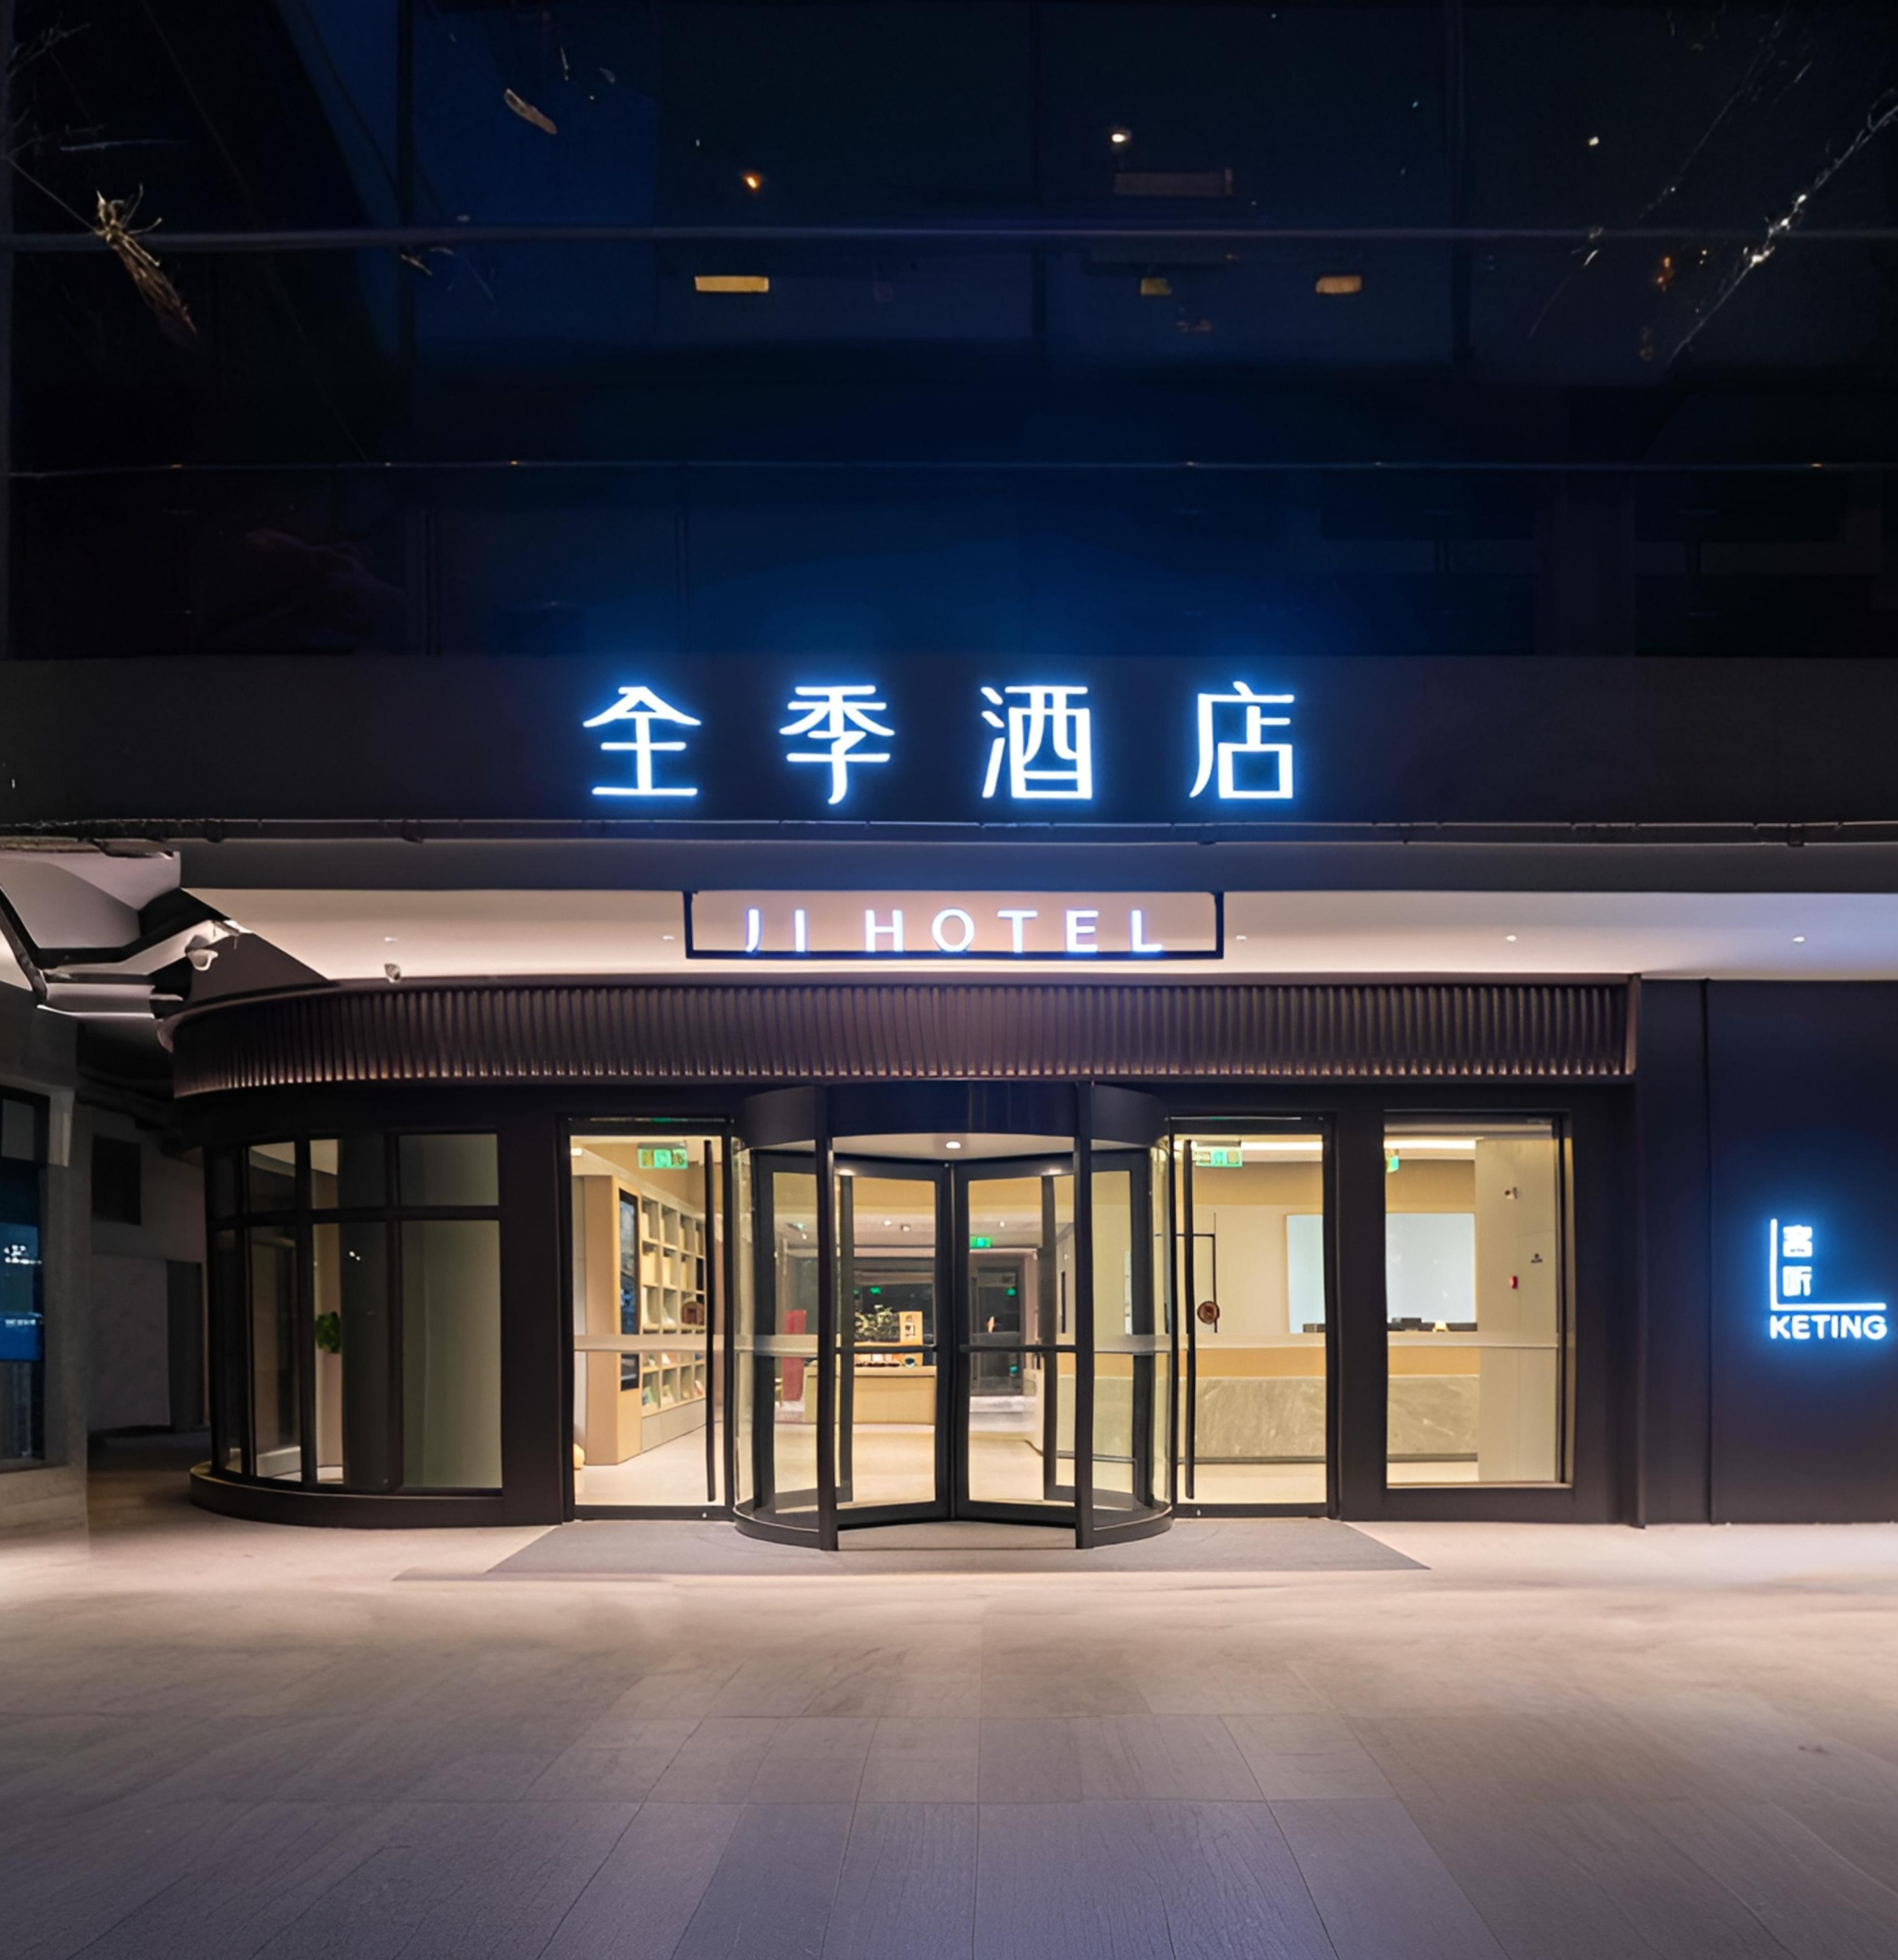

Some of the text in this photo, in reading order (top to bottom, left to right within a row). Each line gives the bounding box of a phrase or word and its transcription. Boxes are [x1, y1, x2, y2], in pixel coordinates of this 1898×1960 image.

[583, 681, 1294, 804] 全季酒店
[746, 908, 1163, 952] JI HOTEL
[1769, 1314, 1888, 1340] KETING
